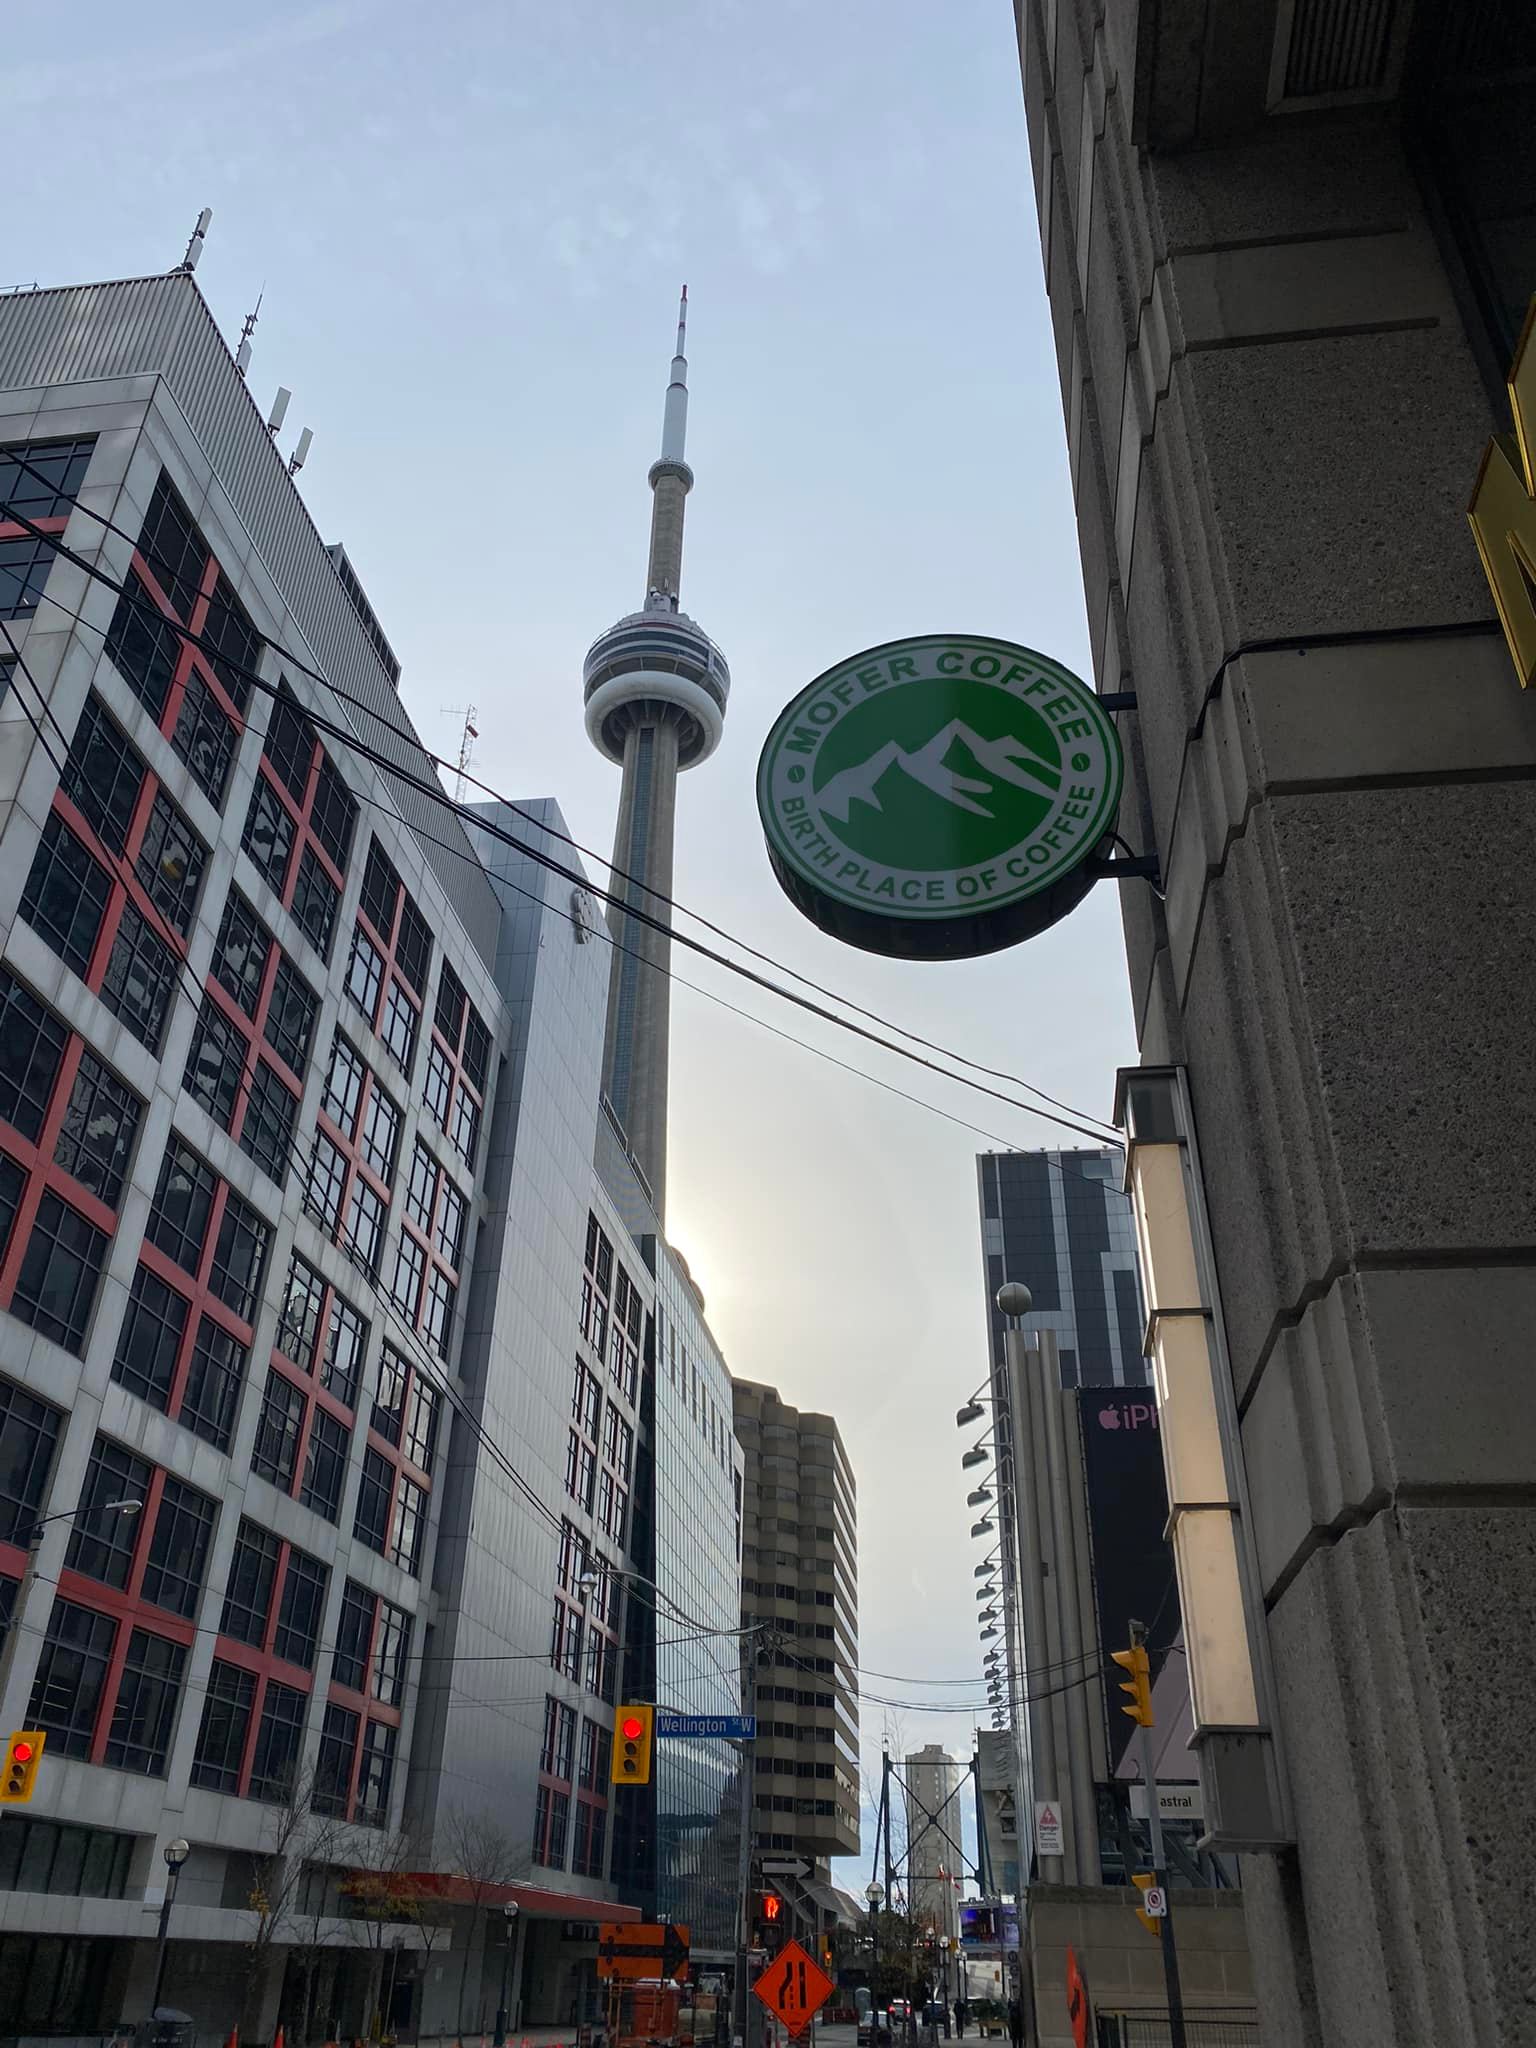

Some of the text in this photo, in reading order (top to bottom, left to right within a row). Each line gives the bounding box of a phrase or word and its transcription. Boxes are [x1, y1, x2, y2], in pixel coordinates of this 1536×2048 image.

[786, 651, 1093, 755] MOFER COFFEE
[781, 784, 1096, 901] BIRTH PLACE OF COFFEE
[660, 1717, 727, 1736] Wellington
[741, 1717, 752, 1732] W
[1160, 1796, 1192, 1807] astral
